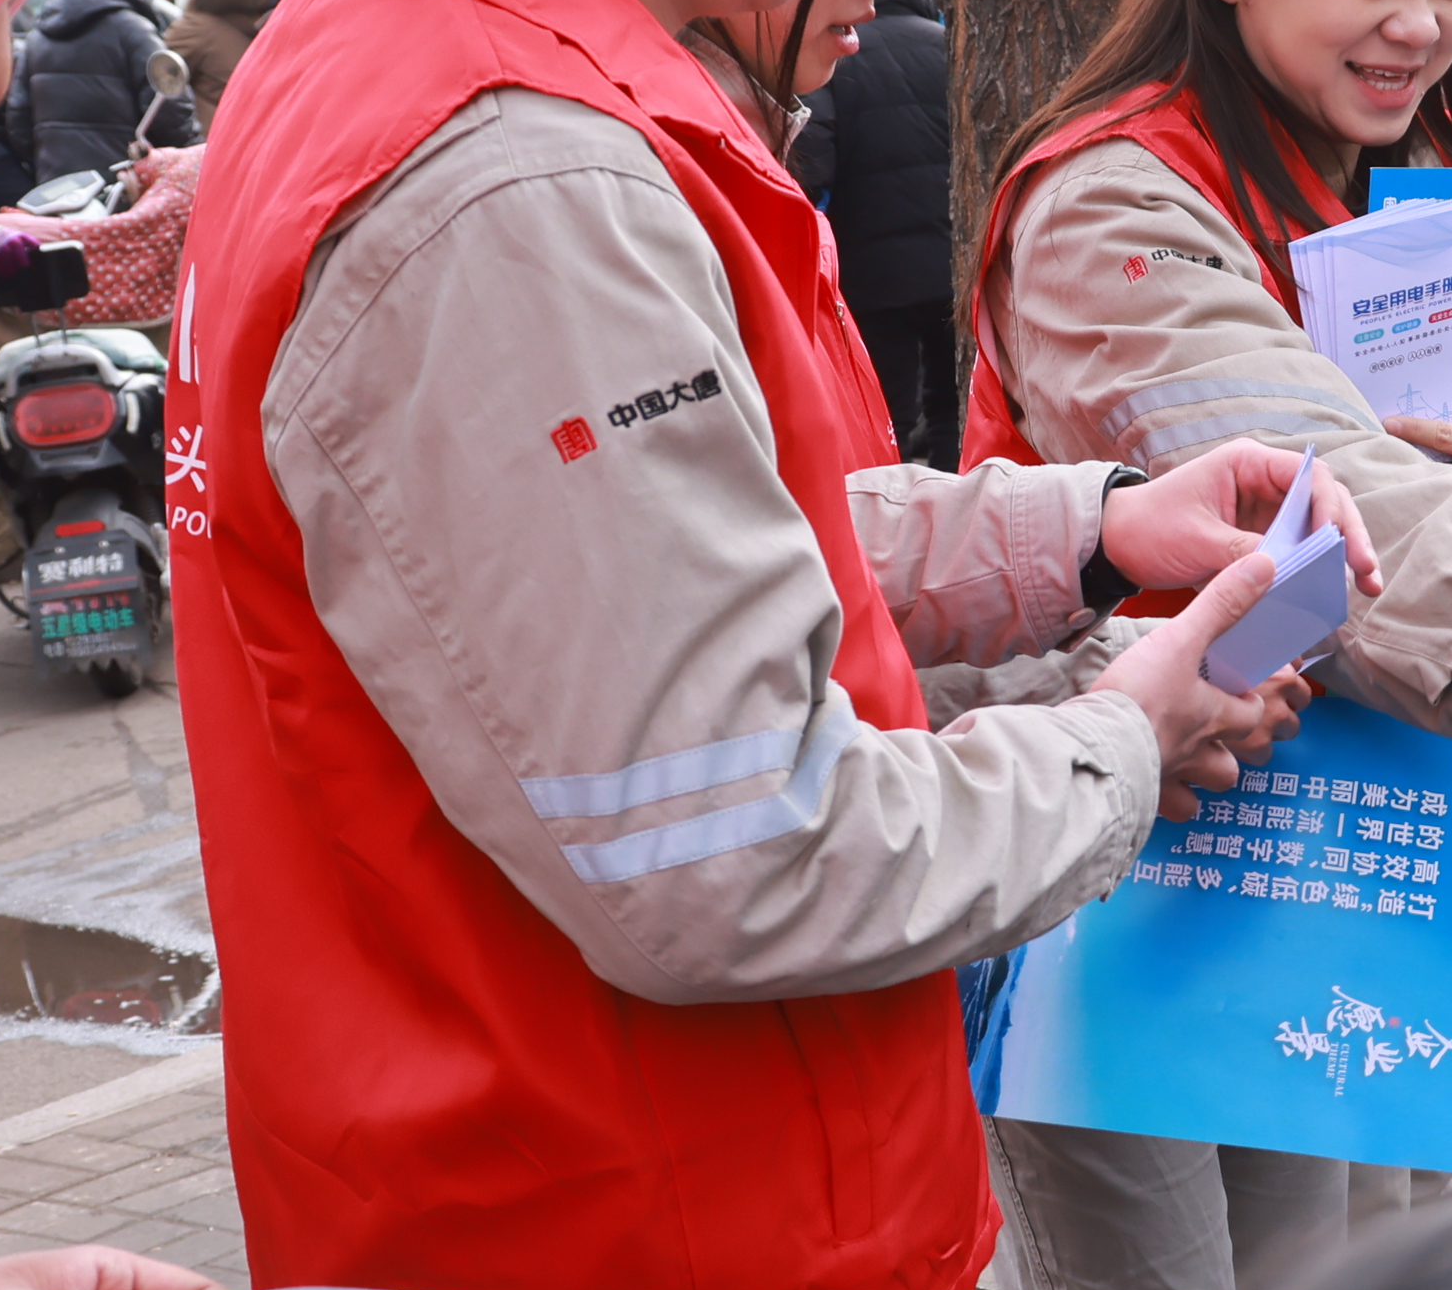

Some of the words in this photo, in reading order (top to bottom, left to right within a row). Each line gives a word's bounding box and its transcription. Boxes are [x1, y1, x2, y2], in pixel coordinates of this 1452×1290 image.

[1360, 313, 1393, 326] PEOPLE'S
[1395, 304, 1426, 317] ELECTRIC
[1428, 296, 1452, 308] POWER
[607, 369, 723, 428] 中国大唐
[1230, 769, 1448, 817] 成为美丽中国建
[1189, 799, 1445, 850] 的世界一流能源供
[1127, 860, 1437, 921] 打造“绿色低碳、多能互
[1326, 1042, 1340, 1079] THEME
[1334, 1043, 1351, 1097] CULTURAL
